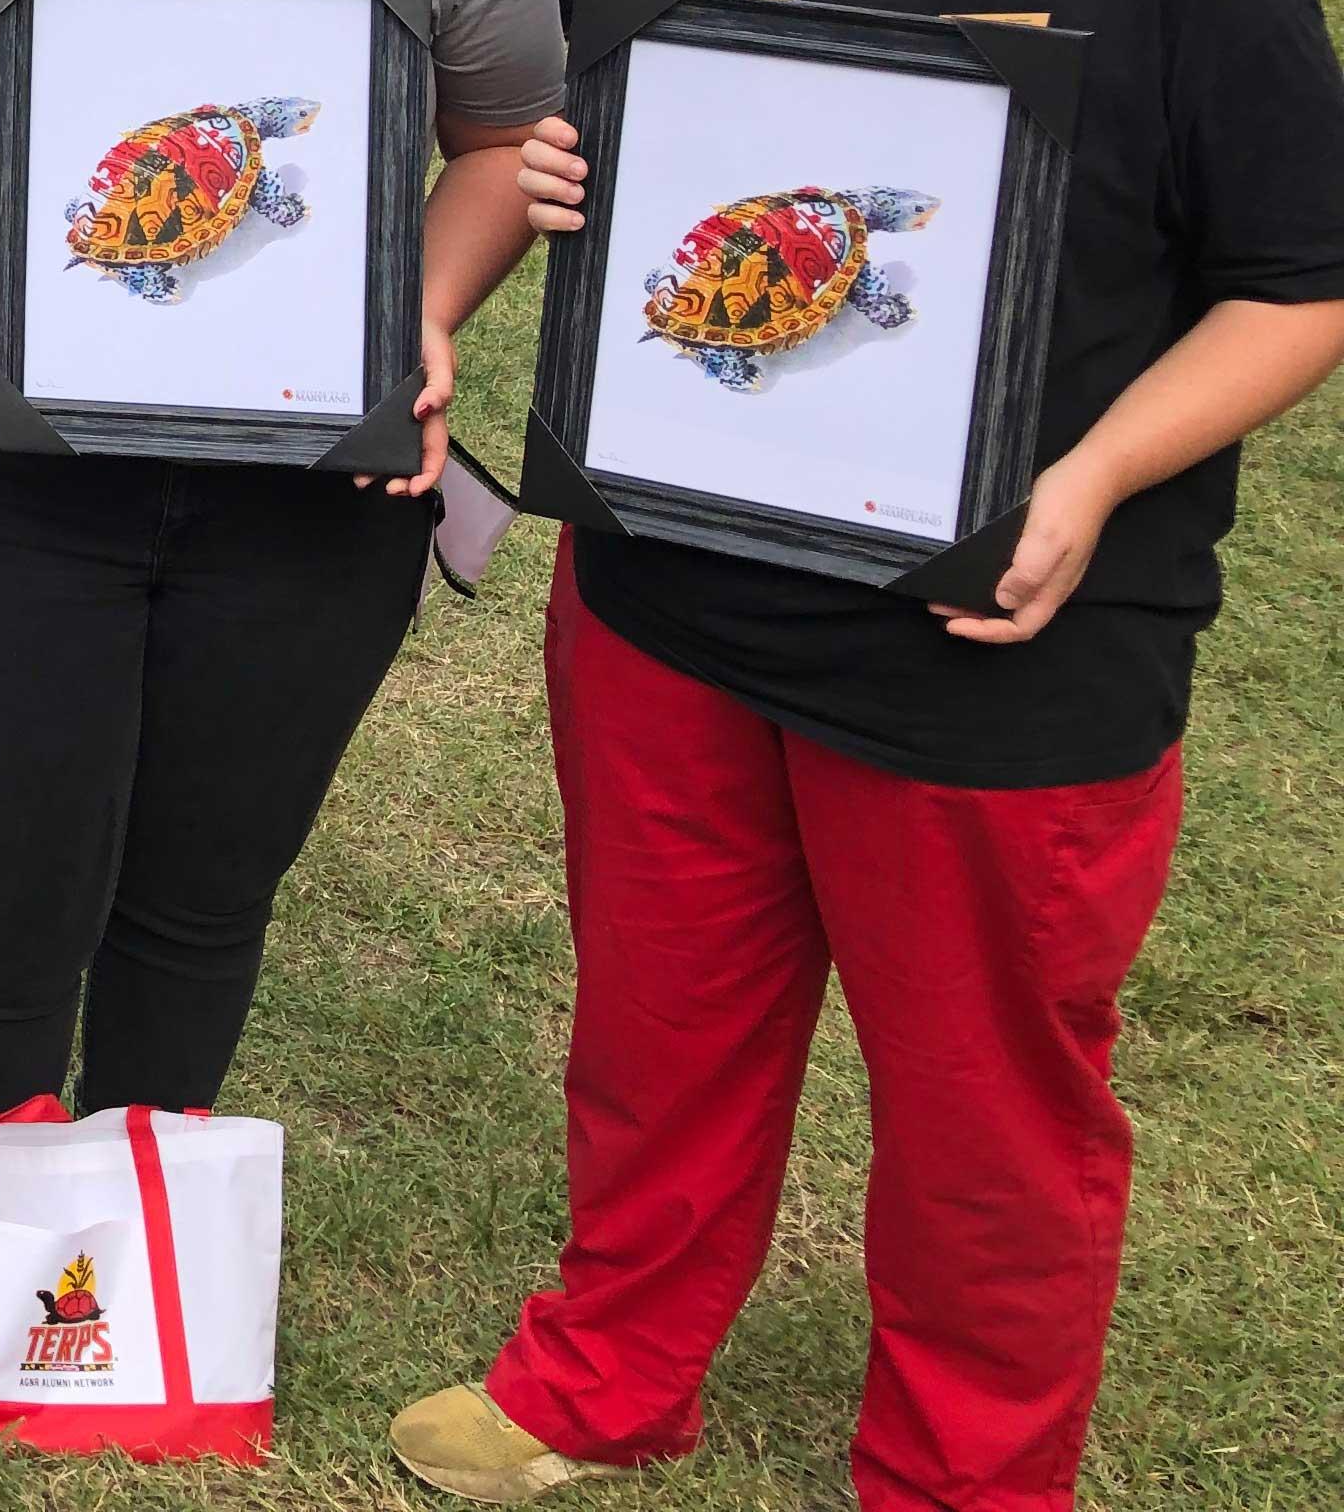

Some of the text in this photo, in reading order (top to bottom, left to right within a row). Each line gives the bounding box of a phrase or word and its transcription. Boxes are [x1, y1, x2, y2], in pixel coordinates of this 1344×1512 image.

[25, 1322, 114, 1363] TERPS
[19, 1377, 114, 1389] AGNR ALUMNI NETWORK
